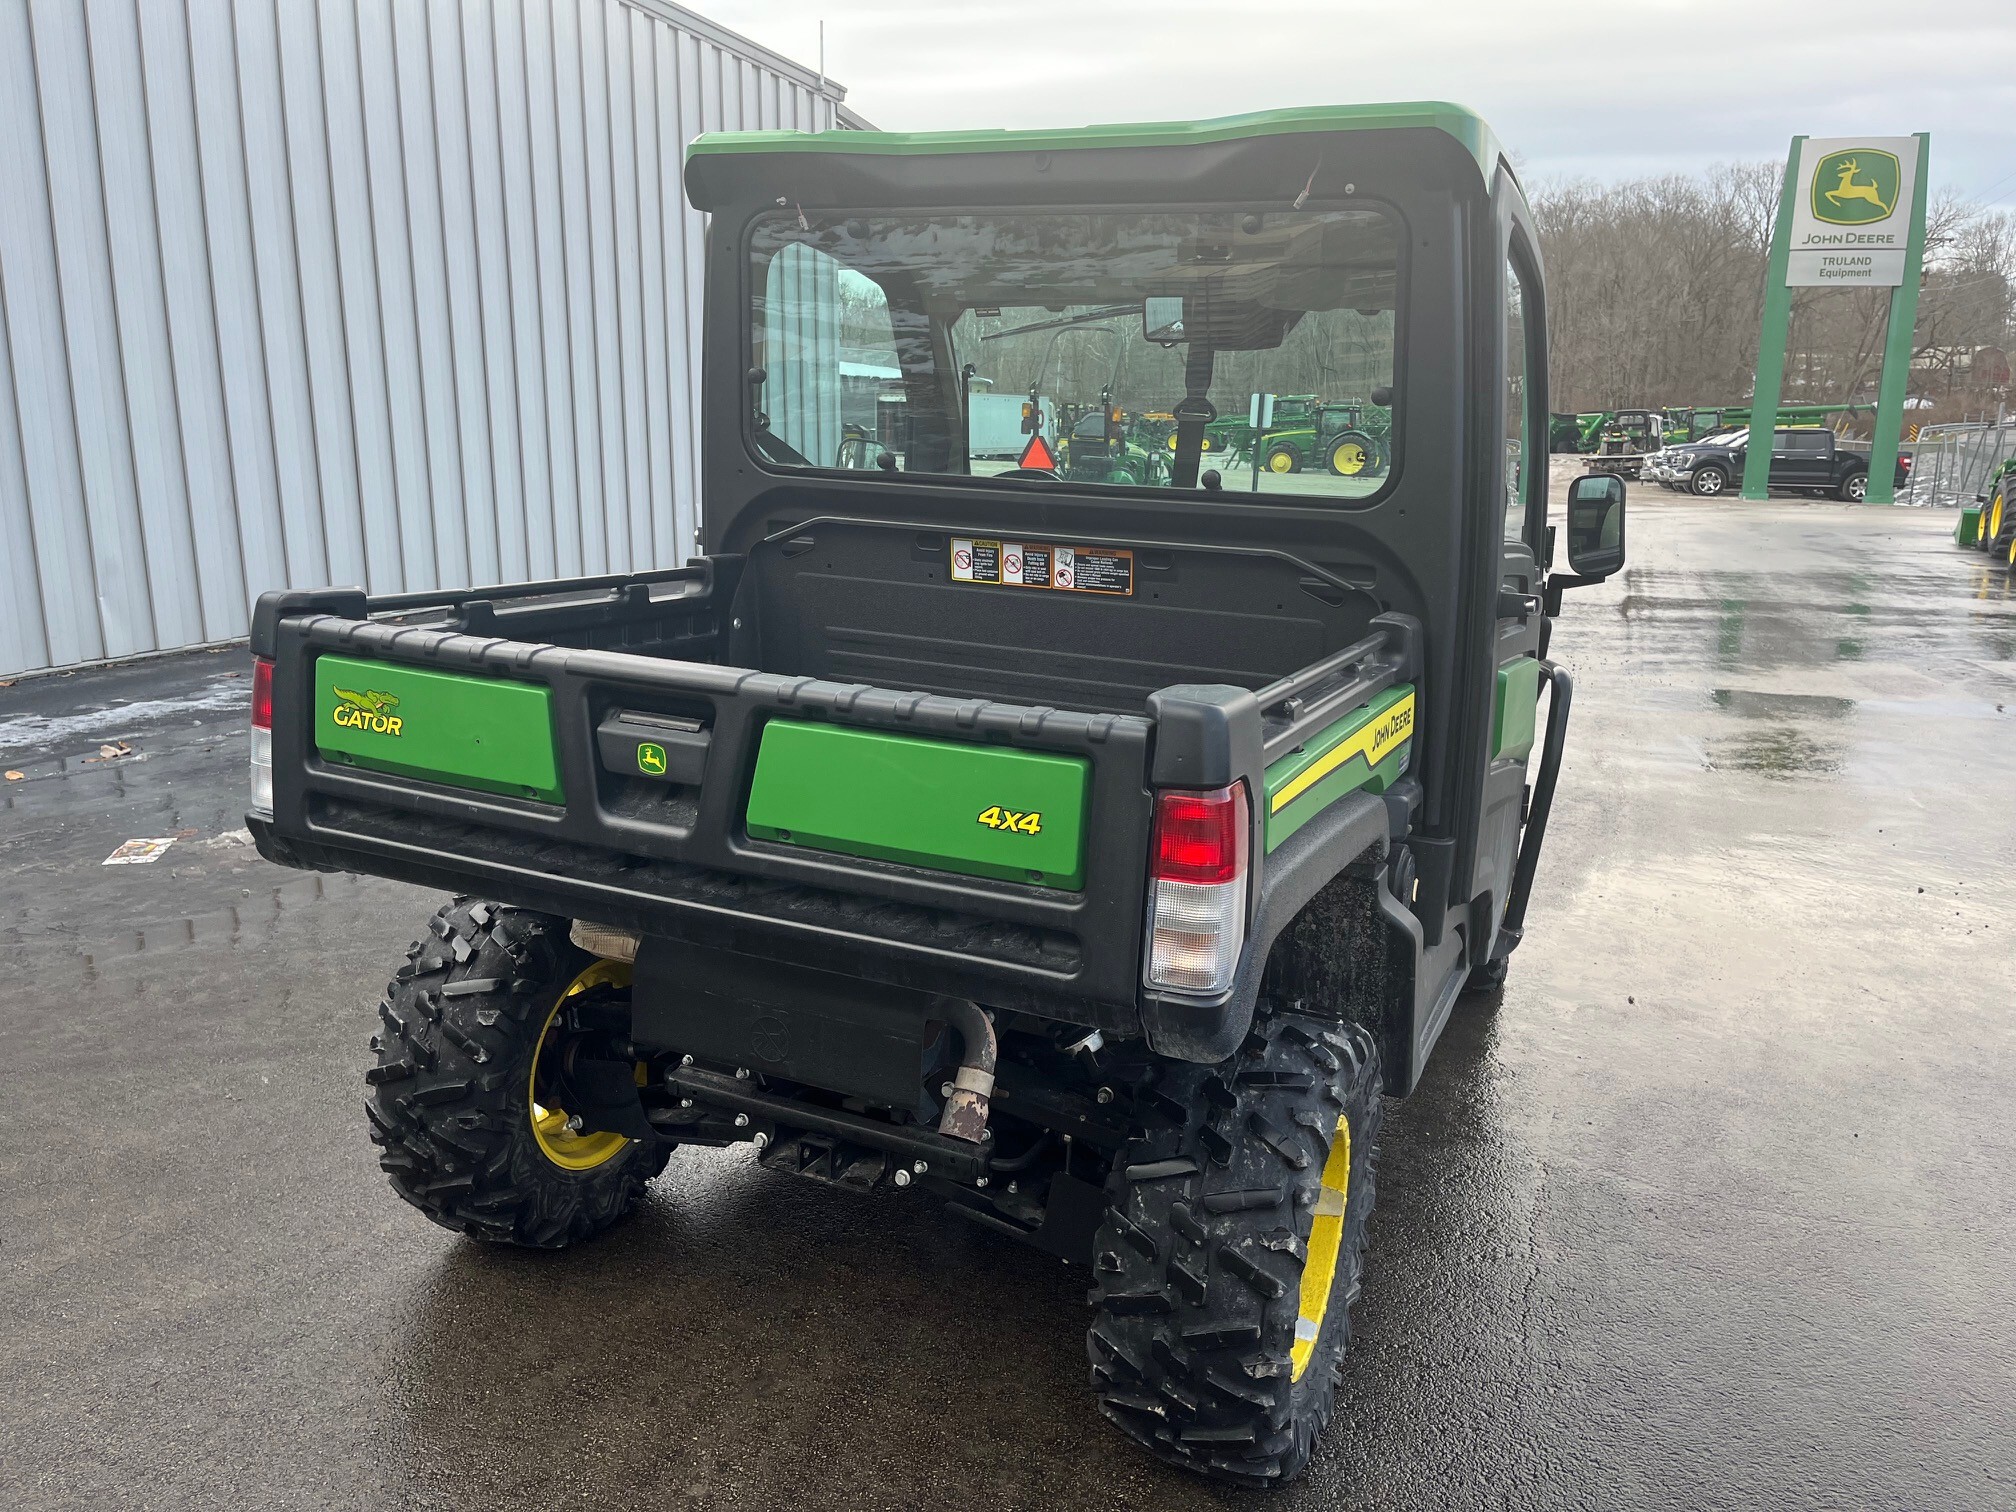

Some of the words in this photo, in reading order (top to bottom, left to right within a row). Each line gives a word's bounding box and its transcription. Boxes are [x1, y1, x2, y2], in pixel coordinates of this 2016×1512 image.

[1802, 233, 1843, 245] JOHN
[1845, 232, 1895, 244] DEERE
[1822, 256, 1872, 266] TRULAND
[1819, 268, 1872, 279] Equipment
[333, 705, 403, 736] GATOR
[1372, 722, 1390, 752] JOHN
[1390, 708, 1412, 737] DEERE
